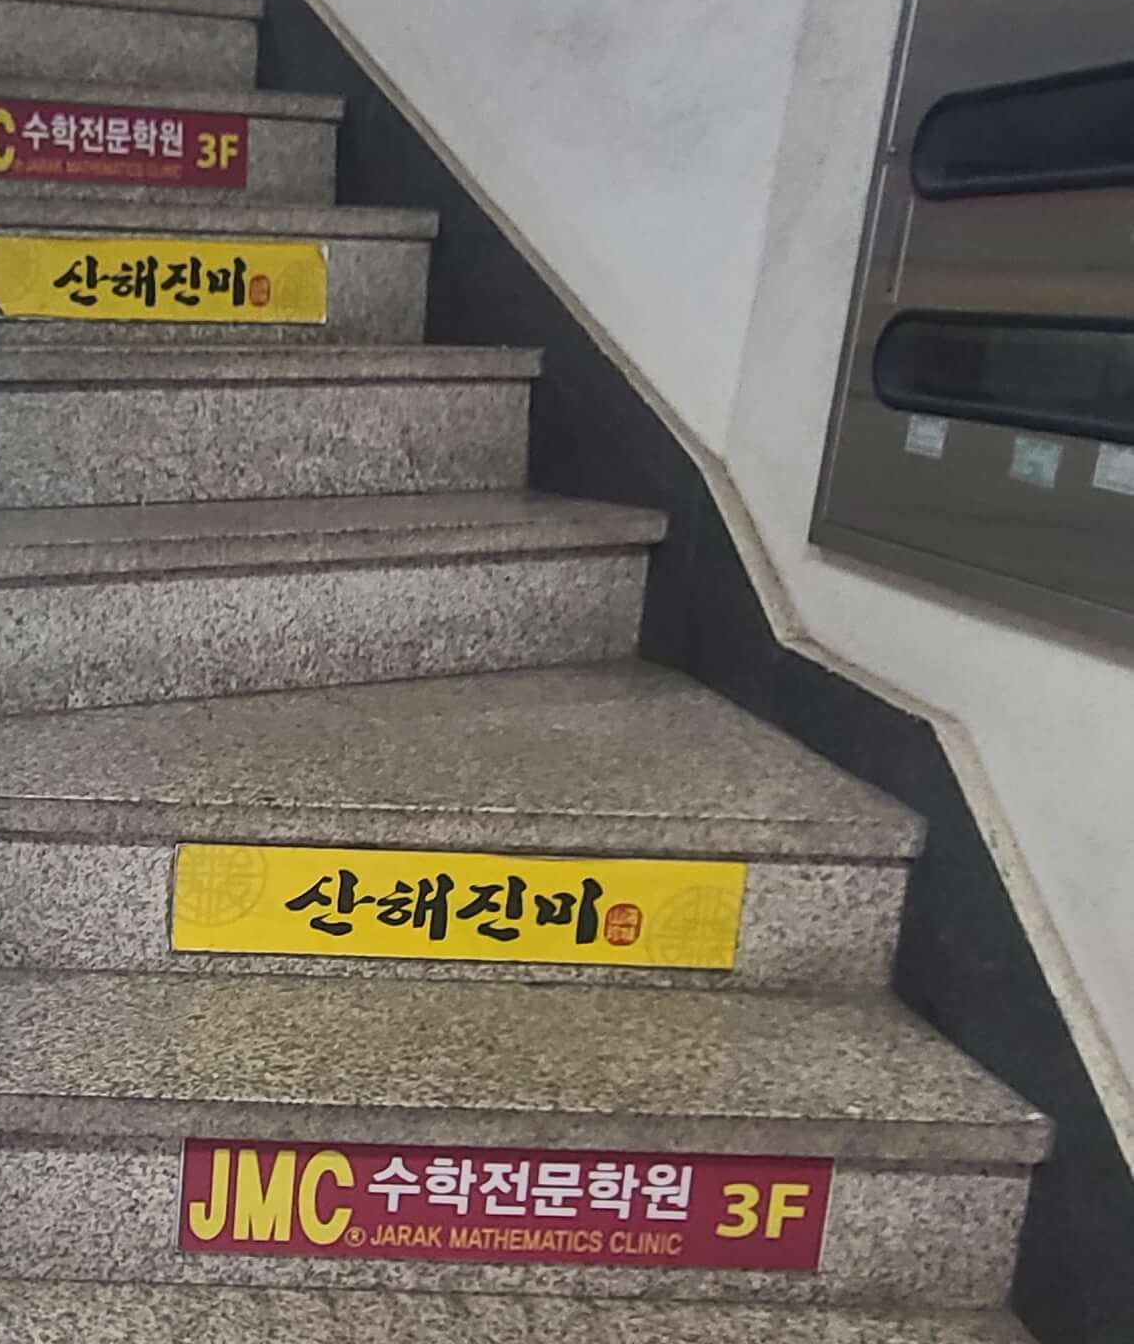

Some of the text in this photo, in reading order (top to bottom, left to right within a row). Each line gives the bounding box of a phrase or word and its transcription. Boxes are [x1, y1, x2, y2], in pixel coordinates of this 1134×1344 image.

[22, 111, 184, 158] 수학전문학원
[196, 132, 240, 170] 3F
[52, 254, 247, 309] 산해진미
[285, 870, 604, 946] 산해진미
[188, 1147, 810, 1246] JMC 수학전문학원 3F
[370, 1224, 684, 1256] JARAK MATHEMATICS CLINIC
